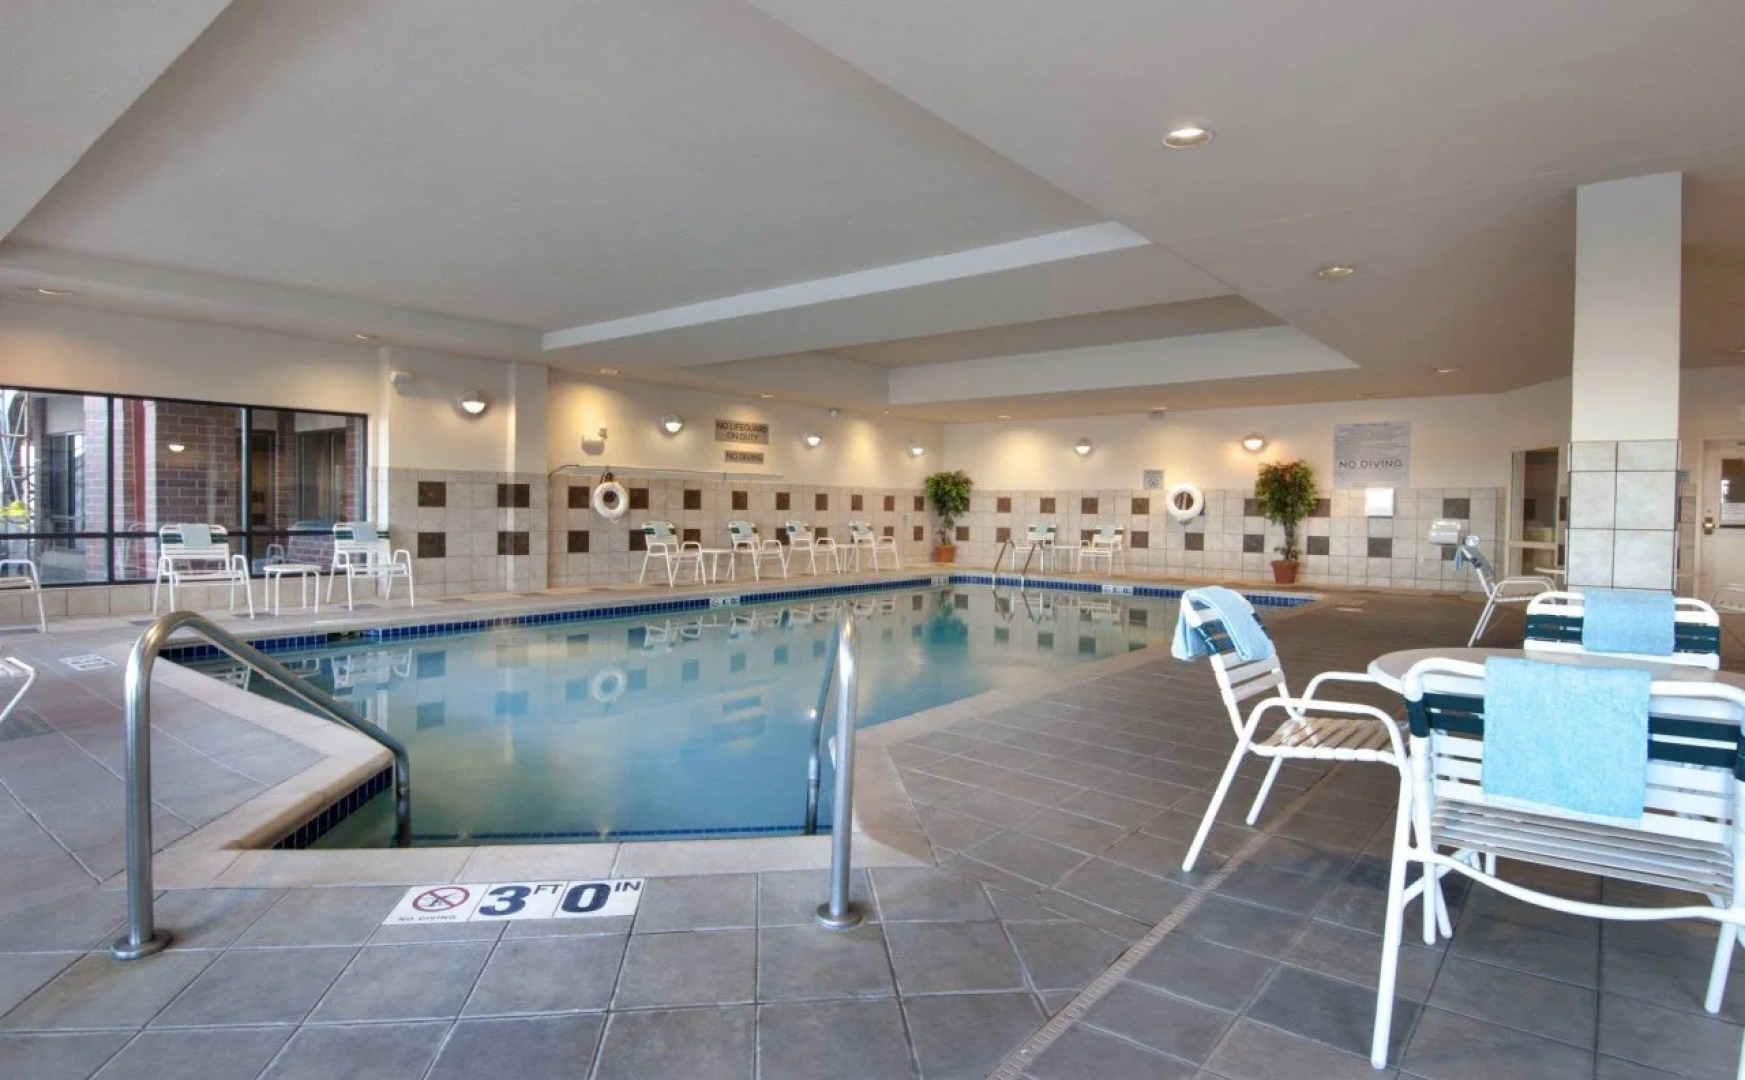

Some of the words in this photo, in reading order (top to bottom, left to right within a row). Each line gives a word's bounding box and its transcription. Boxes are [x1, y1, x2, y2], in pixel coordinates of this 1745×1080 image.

[717, 422, 728, 430] NO
[730, 423, 767, 434] LIFEGUARD
[728, 432, 738, 440] ON
[740, 433, 758, 441] DUTY
[726, 451, 737, 459] NO
[739, 452, 763, 461] DIVING
[1339, 460, 1356, 468] NO
[1360, 459, 1402, 468] DIVING
[479, 885, 530, 916] 3
[534, 884, 563, 895] FT
[561, 883, 611, 912] 0
[615, 881, 642, 892] IN
